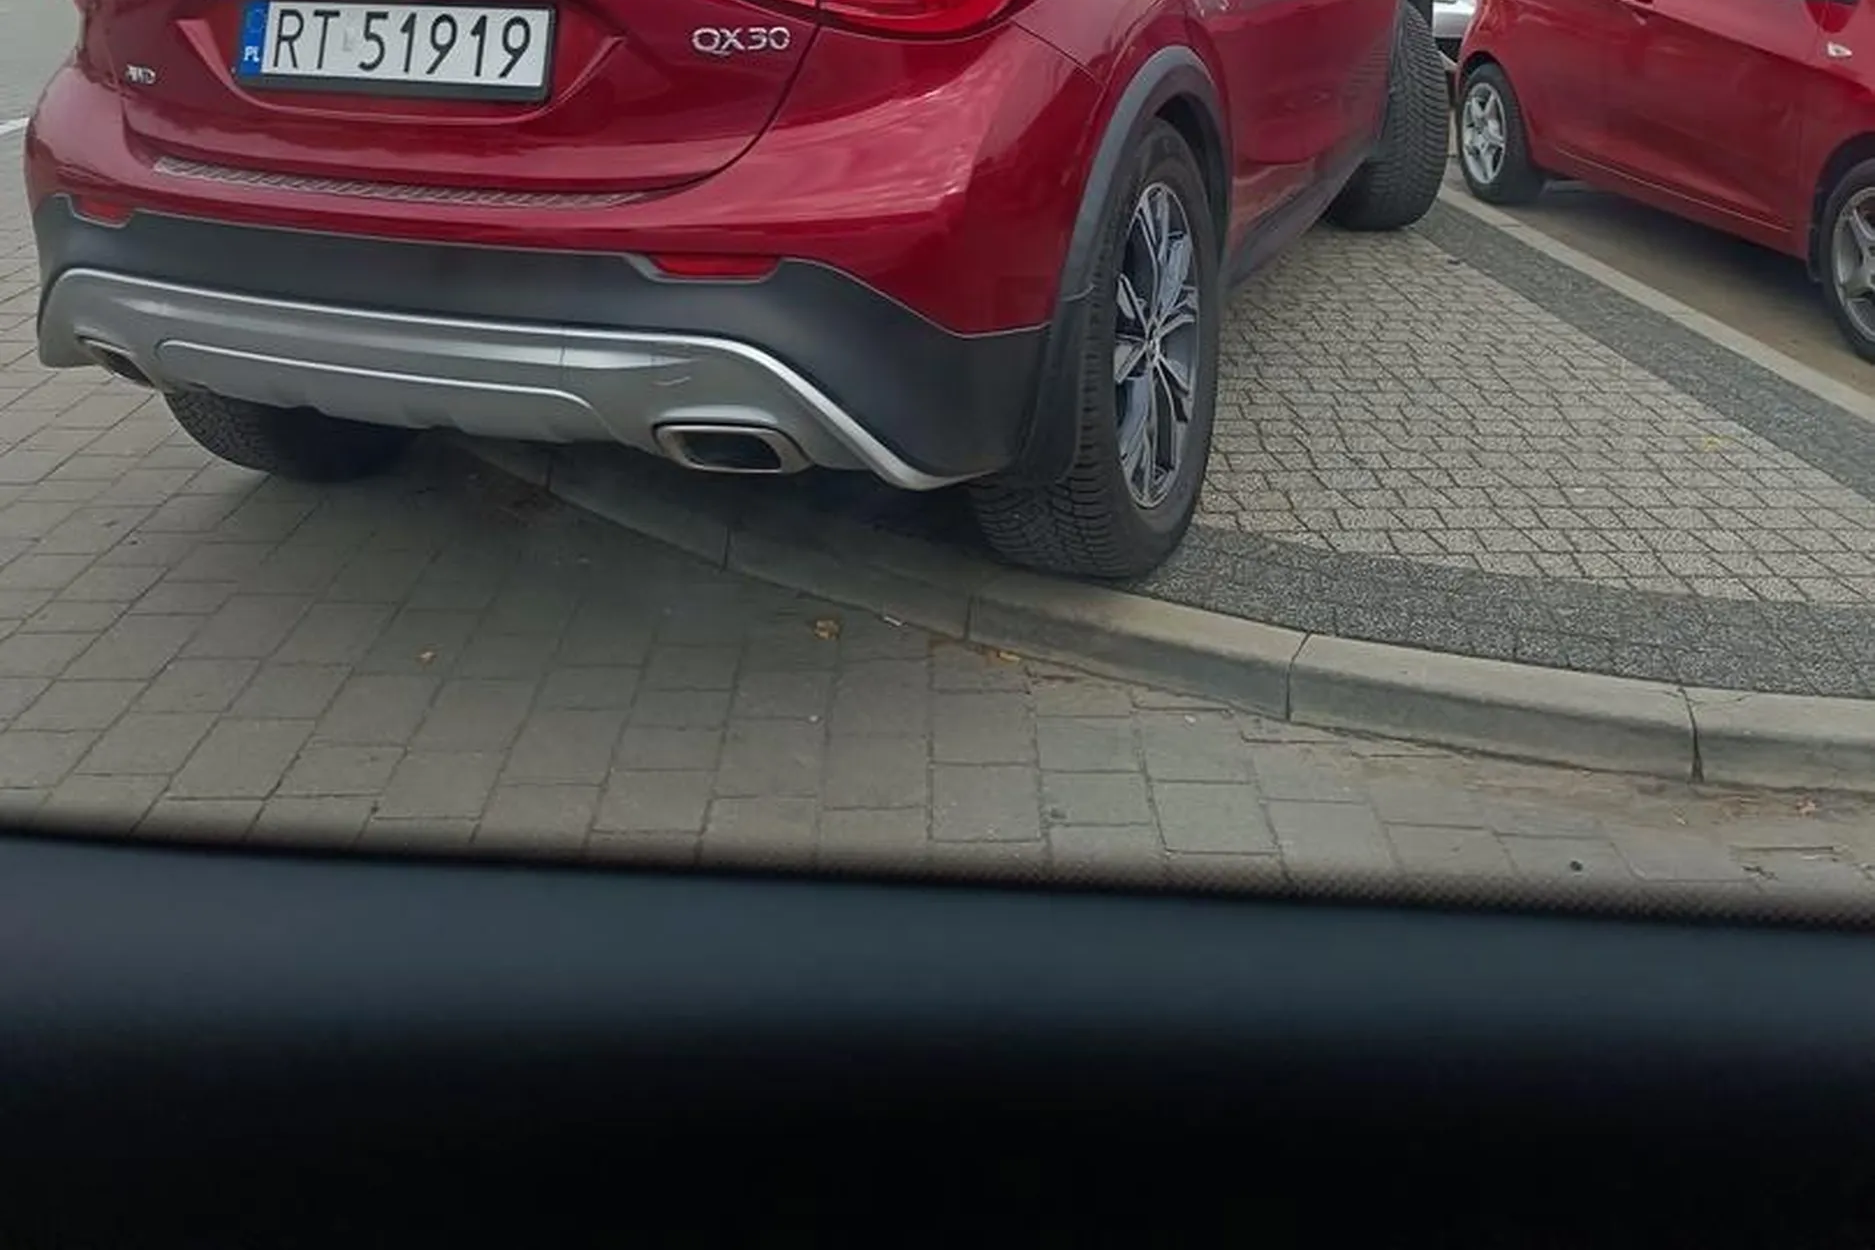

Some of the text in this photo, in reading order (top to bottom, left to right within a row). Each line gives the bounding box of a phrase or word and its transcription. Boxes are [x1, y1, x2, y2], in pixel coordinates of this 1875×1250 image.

[243, 45, 260, 62] PL
[272, 8, 532, 79] RT 51919
[691, 26, 791, 56] QX30
